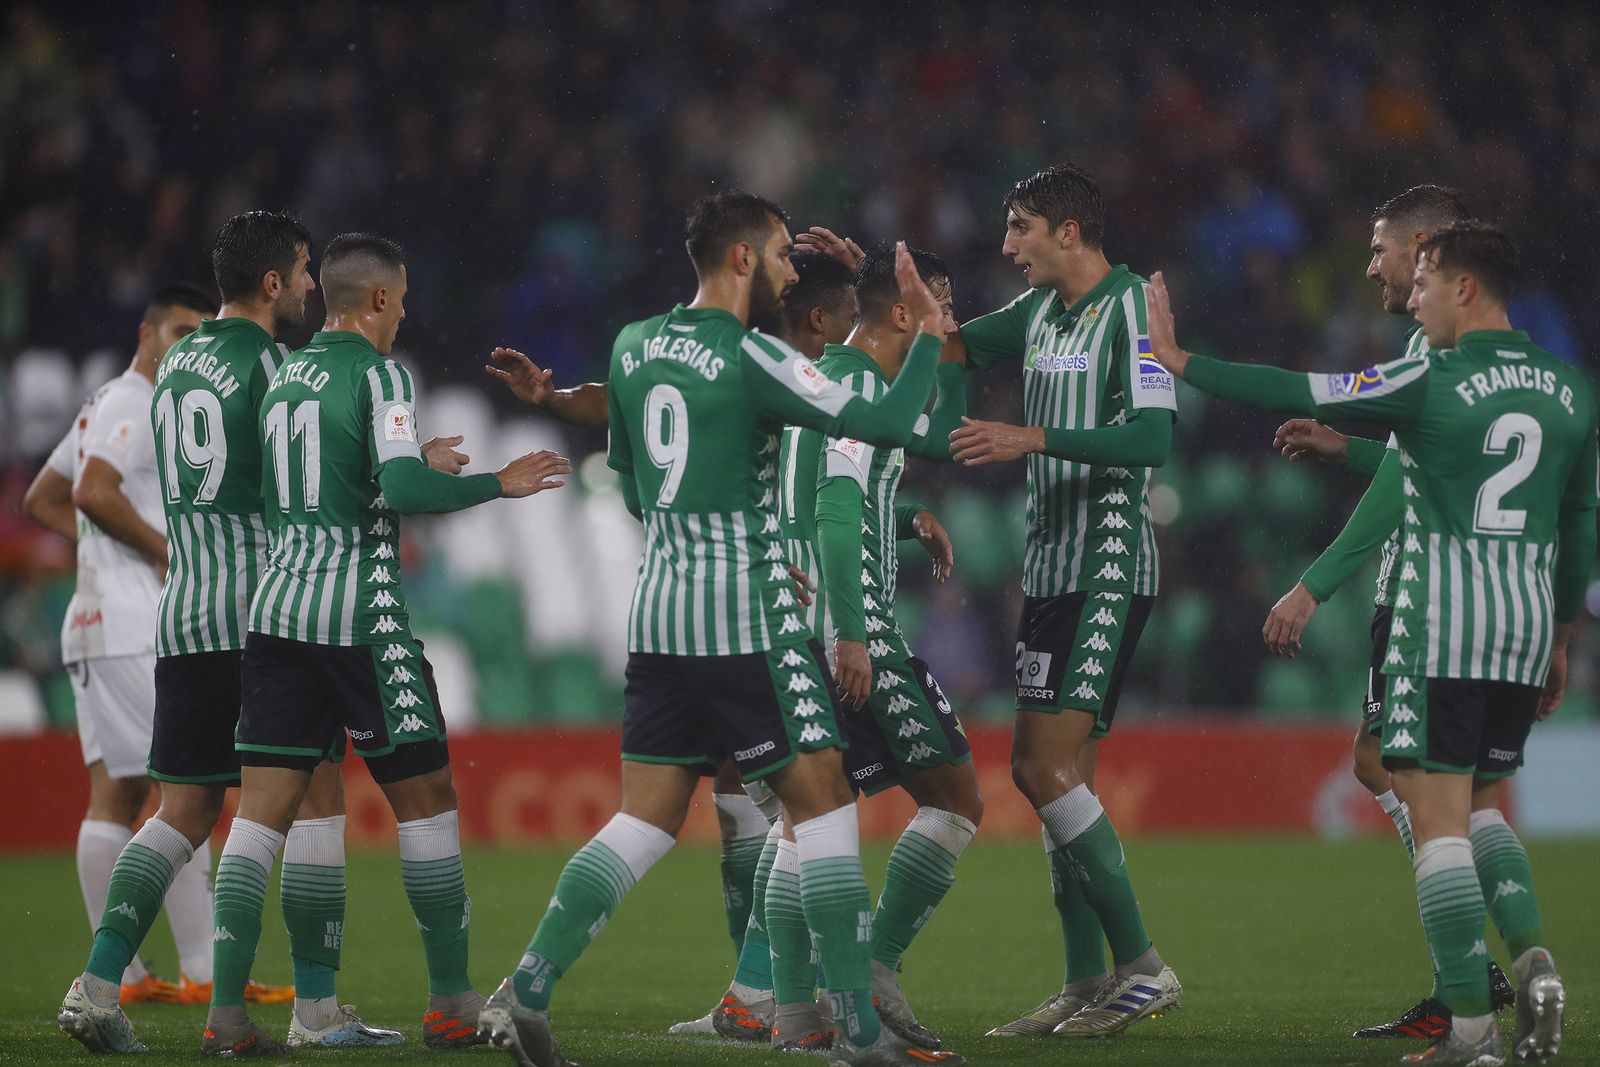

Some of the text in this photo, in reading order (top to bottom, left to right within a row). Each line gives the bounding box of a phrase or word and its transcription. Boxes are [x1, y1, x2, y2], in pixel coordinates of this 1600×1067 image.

[157, 351, 241, 399] BARRAGÁN
[269, 360, 330, 393] C. TELLO
[621, 335, 725, 382] B. IGLESIAS
[1140, 376, 1172, 386] REALE
[1455, 364, 1575, 415] FRANCIS G.
[154, 388, 228, 506] 19
[263, 400, 321, 514] 11
[643, 384, 689, 509] 9
[1472, 412, 1543, 536] 2
[852, 762, 884, 780] appa
